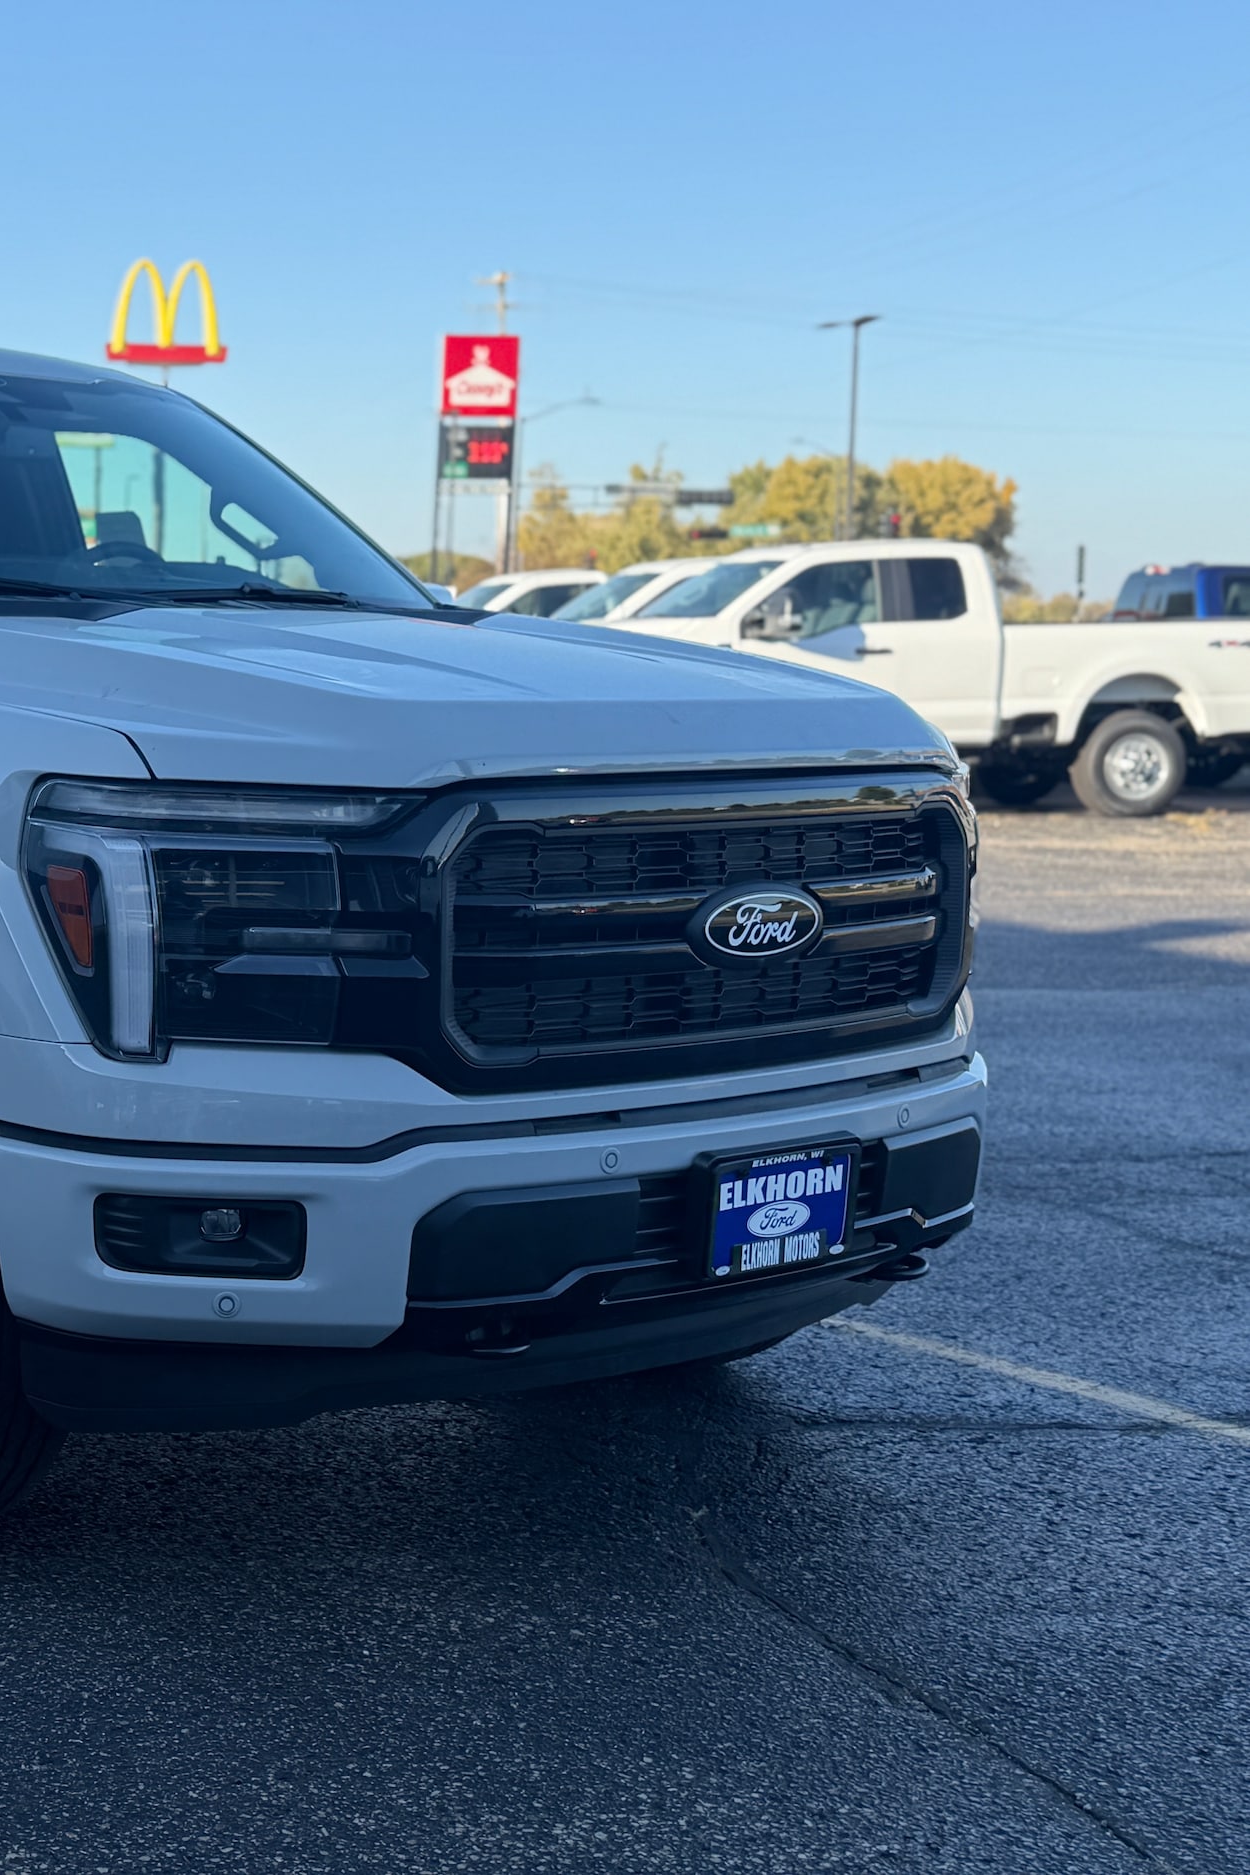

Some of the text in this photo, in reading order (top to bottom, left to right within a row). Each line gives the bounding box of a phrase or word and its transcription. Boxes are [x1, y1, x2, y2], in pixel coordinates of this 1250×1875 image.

[728, 903, 799, 947] Ford
[752, 1149, 825, 1168] ELKHORN, WI
[719, 1164, 844, 1212] ELKHORN
[759, 1206, 798, 1231] Ford
[741, 1231, 820, 1272] ELKHORN MOTORS
